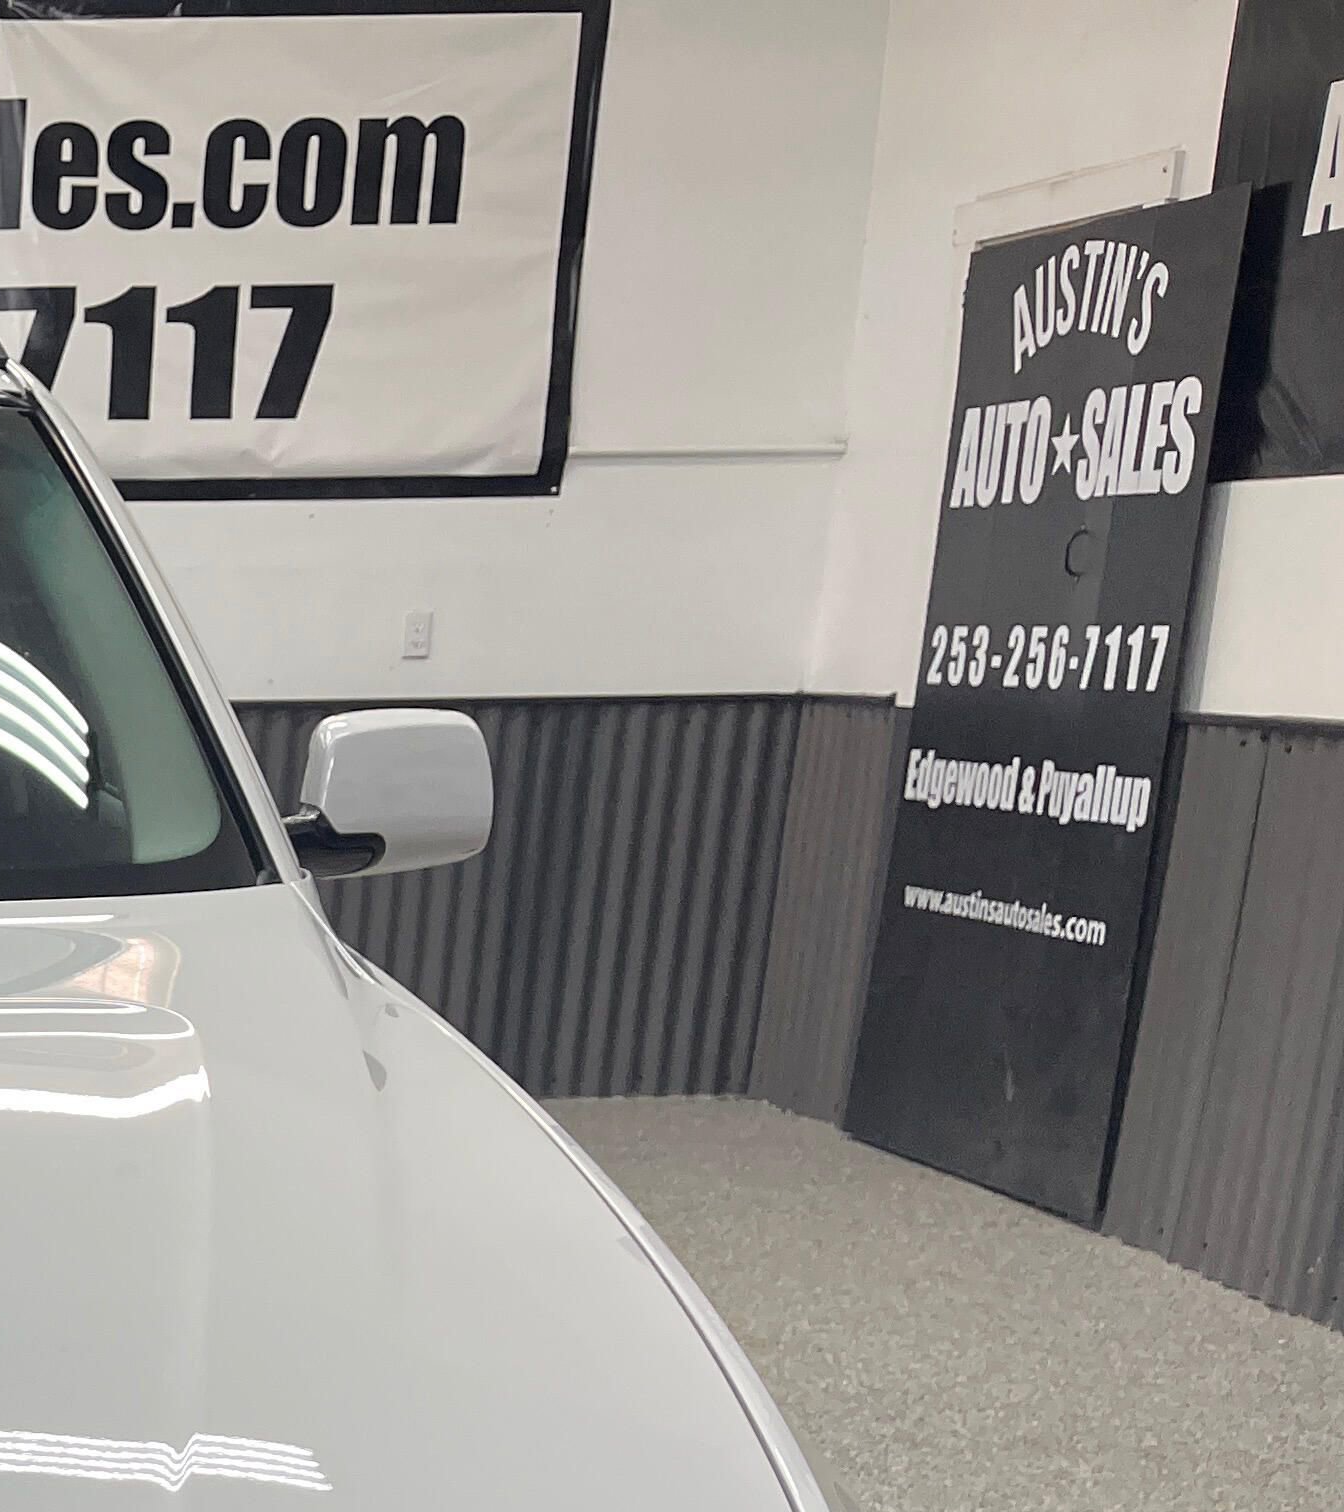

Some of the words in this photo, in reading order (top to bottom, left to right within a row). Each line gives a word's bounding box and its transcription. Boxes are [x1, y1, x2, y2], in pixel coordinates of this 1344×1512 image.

[1013, 240, 1169, 375] AUSTIN'S
[949, 396, 1052, 508] AUTO
[1076, 376, 1203, 501] SALES
[926, 624, 1171, 692] 253-256-7117
[904, 748, 1021, 810] Edgewood
[1018, 765, 1036, 814] &
[1036, 759, 1152, 833] Puyallup
[904, 885, 1108, 946] www.austinsautosales.com
